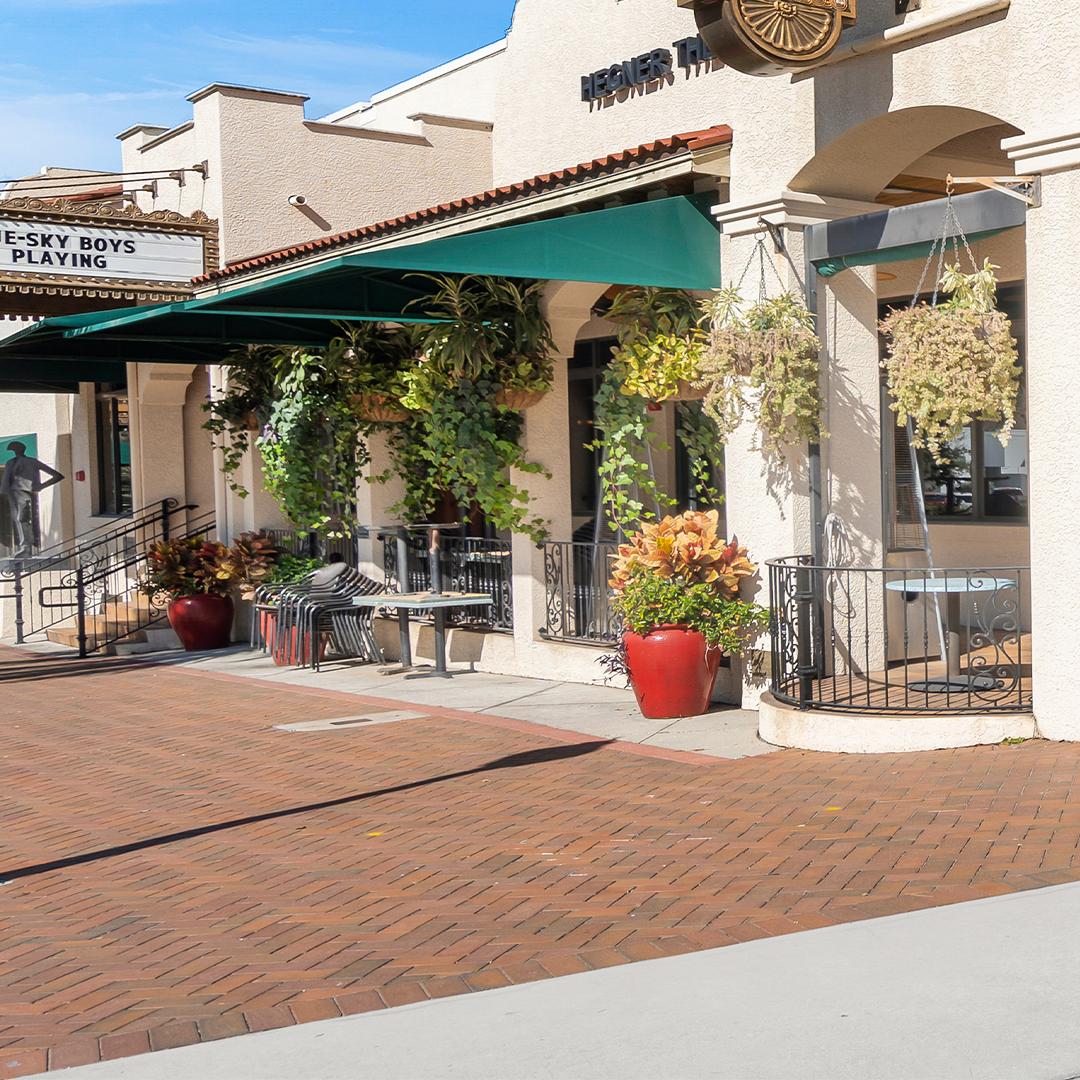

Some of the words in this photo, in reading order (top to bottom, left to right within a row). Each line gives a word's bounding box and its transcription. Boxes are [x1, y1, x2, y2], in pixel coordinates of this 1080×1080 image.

[581, 48, 674, 102] HEGNER
[0, 230, 70, 249] E-SKY
[79, 236, 136, 254] BOYS
[11, 248, 107, 269] PLAYING
